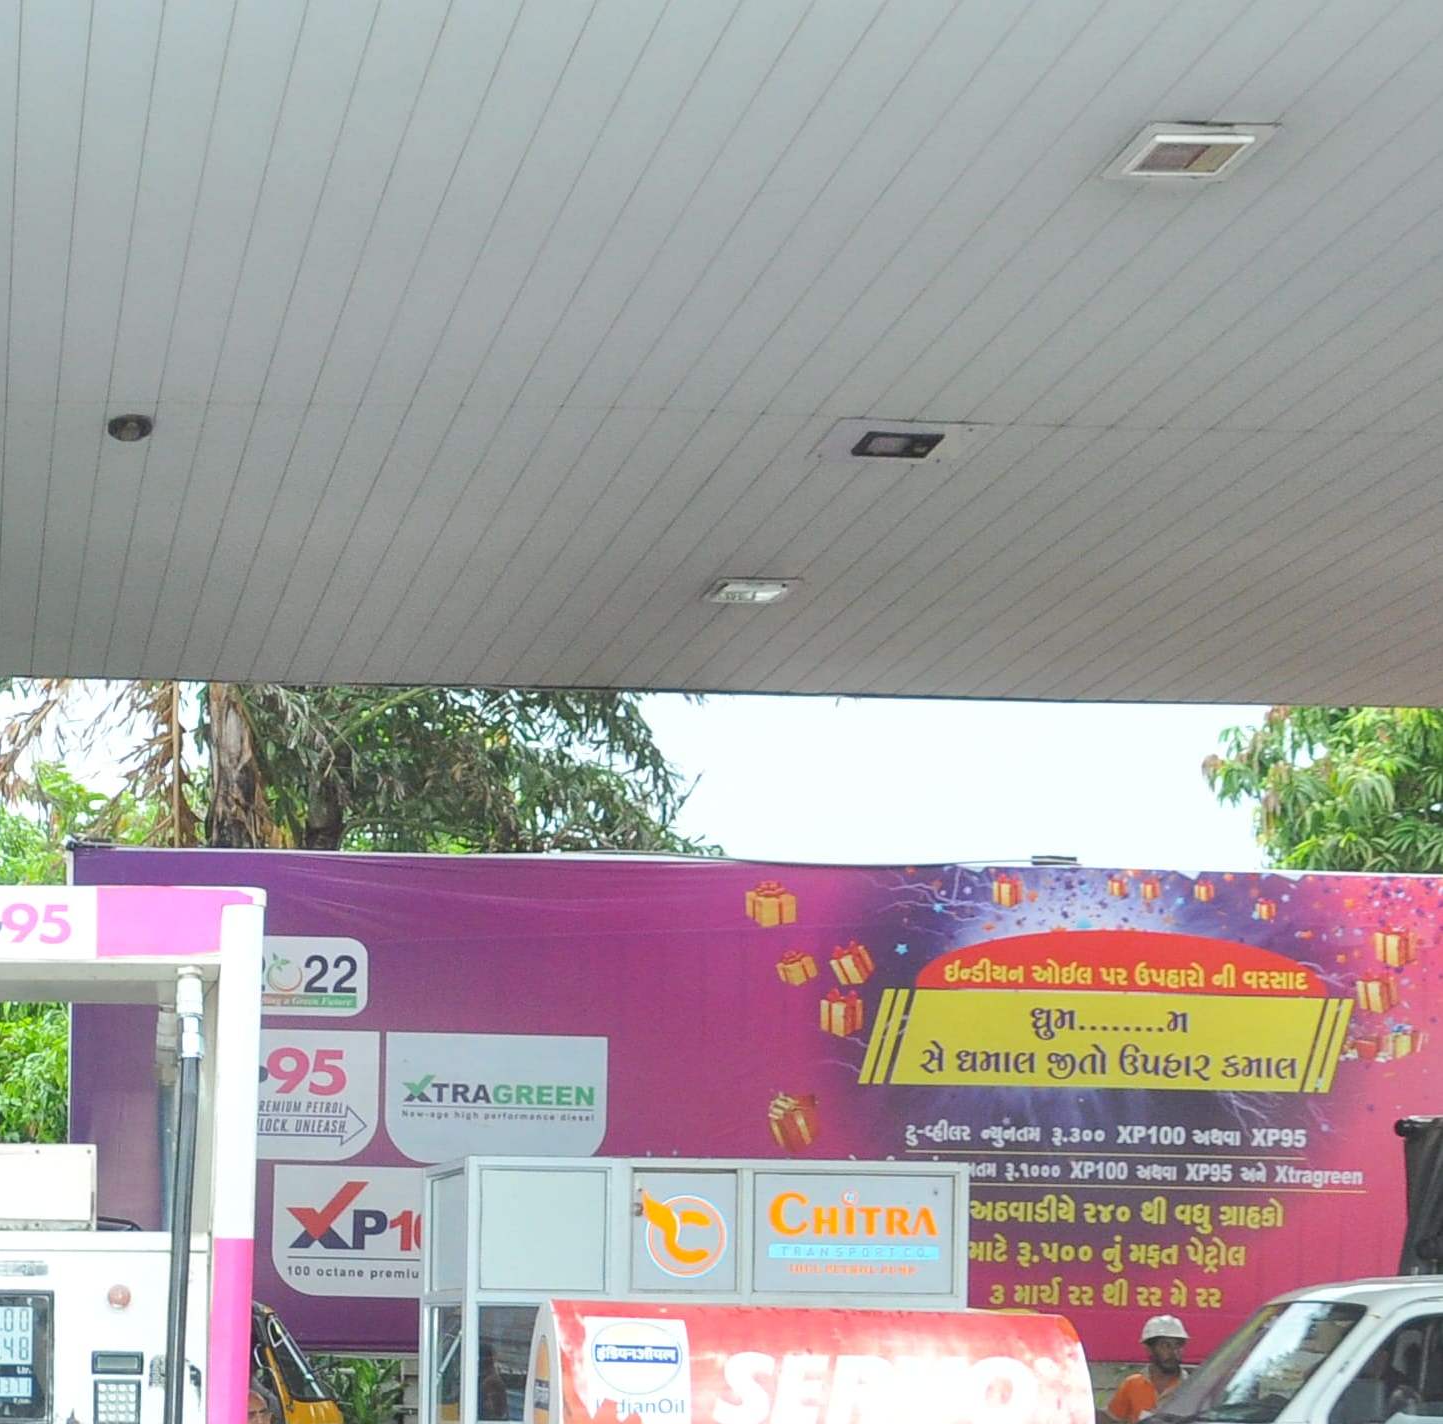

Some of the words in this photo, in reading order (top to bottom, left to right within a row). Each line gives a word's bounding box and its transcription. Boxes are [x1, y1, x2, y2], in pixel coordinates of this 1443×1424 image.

[1100, 969, 1128, 986] પર
[1135, 962, 1205, 987] ઉપહારો
[1211, 963, 1235, 988] ની
[1242, 971, 1309, 990] વરસાદ
[920, 1040, 945, 1073] સે
[956, 1049, 1035, 1074] ધમાલ
[1047, 1044, 1107, 1079] જીતો
[1120, 1044, 1210, 1081] ઉપહાર
[1221, 1053, 1297, 1079] કમાલ
[402, 1074, 595, 1107] XTRAGREEN
[259, 1100, 302, 1113] REMIUM
[306, 1101, 345, 1115] PETROL
[454, 1110, 479, 1121] high
[484, 1111, 555, 1121] performance
[561, 1112, 595, 1122] diesel
[1116, 1125, 1185, 1145] XP100
[1192, 1128, 1241, 1146] અથવા
[1251, 1128, 1306, 1148] XP95
[1070, 1161, 1128, 1180] XP100
[1136, 1164, 1177, 1181] અથવા
[1185, 1163, 1232, 1182] XP95
[1240, 1162, 1267, 1183] અને
[1275, 1165, 1362, 1188] Xtragreen
[1141, 1199, 1167, 1225] થી
[1175, 1204, 1213, 1234] વધુ
[1219, 1198, 1284, 1229] ગ્રાહકો
[780, 1246, 895, 1257] TRANSPORT
[969, 1233, 1008, 1263] માટે
[1102, 1235, 1124, 1272] નું
[1186, 1237, 1246, 1273] પેટ્રોલ
[287, 1265, 311, 1277] 100
[316, 1266, 364, 1278] octane
[370, 1267, 419, 1281] premiu
[1014, 1277, 1062, 1306] માર્ચ
[1102, 1279, 1128, 1307] થી
[1170, 1279, 1188, 1307] મે
[595, 1398, 685, 1414] IdianOil
